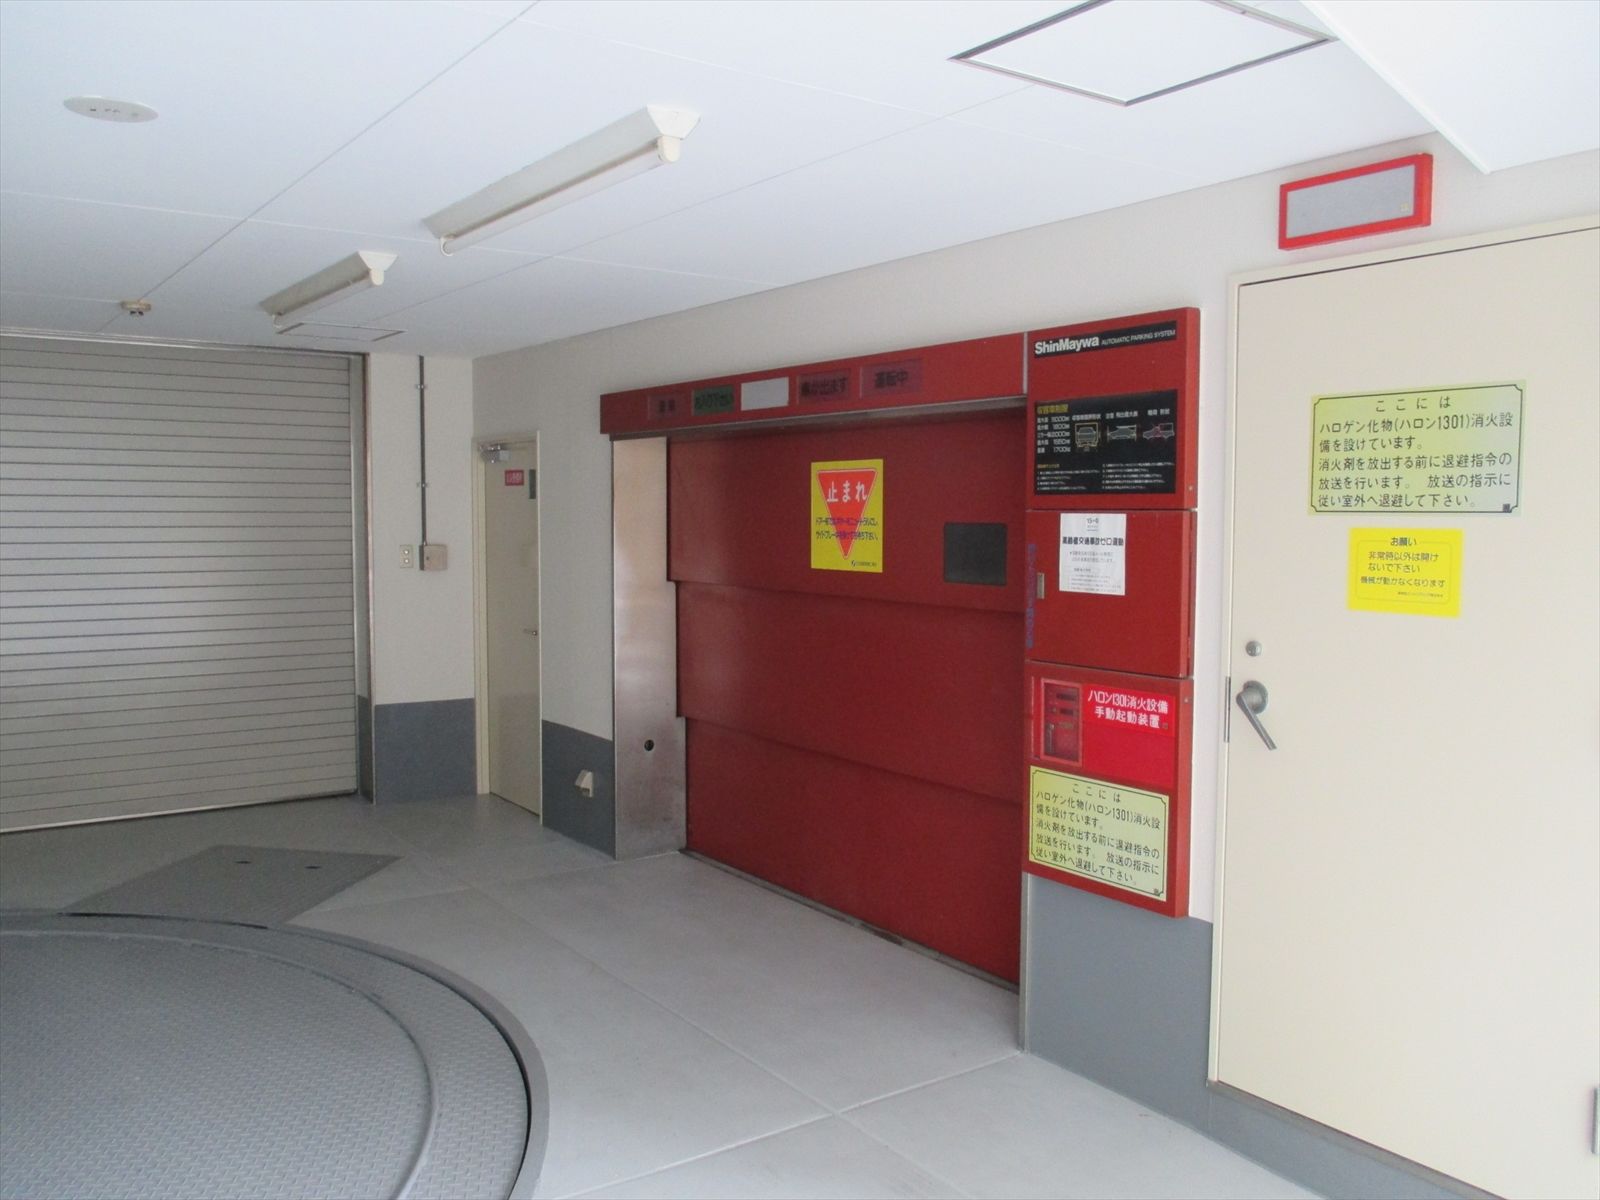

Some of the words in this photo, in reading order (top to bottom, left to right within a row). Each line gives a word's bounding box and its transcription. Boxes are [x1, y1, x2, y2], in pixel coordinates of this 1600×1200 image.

[1034, 336, 1100, 355] ShinMaywa
[1101, 335, 1130, 346] AUTOMATIC
[1130, 332, 1153, 342] PARKING
[1153, 329, 1176, 339] SYSTEM
[1375, 395, 1451, 413] ここには
[1319, 412, 1514, 434] ハロゲン化物(ハロン1301)消火設
[1319, 435, 1423, 453] 備を設けています。
[1318, 452, 1512, 471] 消火剤を放出する前に退避指令の
[826, 480, 868, 503] 止まれ
[1318, 475, 1410, 490] 放送を行います。
[1427, 473, 1511, 489] 放送の指示に
[1318, 493, 1476, 508] 従い室外へ退避して下さい。
[1390, 537, 1417, 547] お願い
[1368, 551, 1440, 562] 非常時以外は開け
[1368, 562, 1421, 573] ないで下さい
[1360, 576, 1446, 588] 機械が動かなくなります
[1088, 690, 1168, 715] ハロン1301消火設備
[1095, 706, 1160, 729] 手動起動装置
[1072, 783, 1121, 803] ここには
[1036, 804, 1103, 830] 備を設けています。
[1036, 820, 1160, 860] 消火剤を放出する前に退避指令の
[1036, 834, 1096, 859] 放送を行います。
[1106, 852, 1159, 876] 放送の指示に
[1036, 846, 1137, 886] 従い室外へ退避して下さい。
